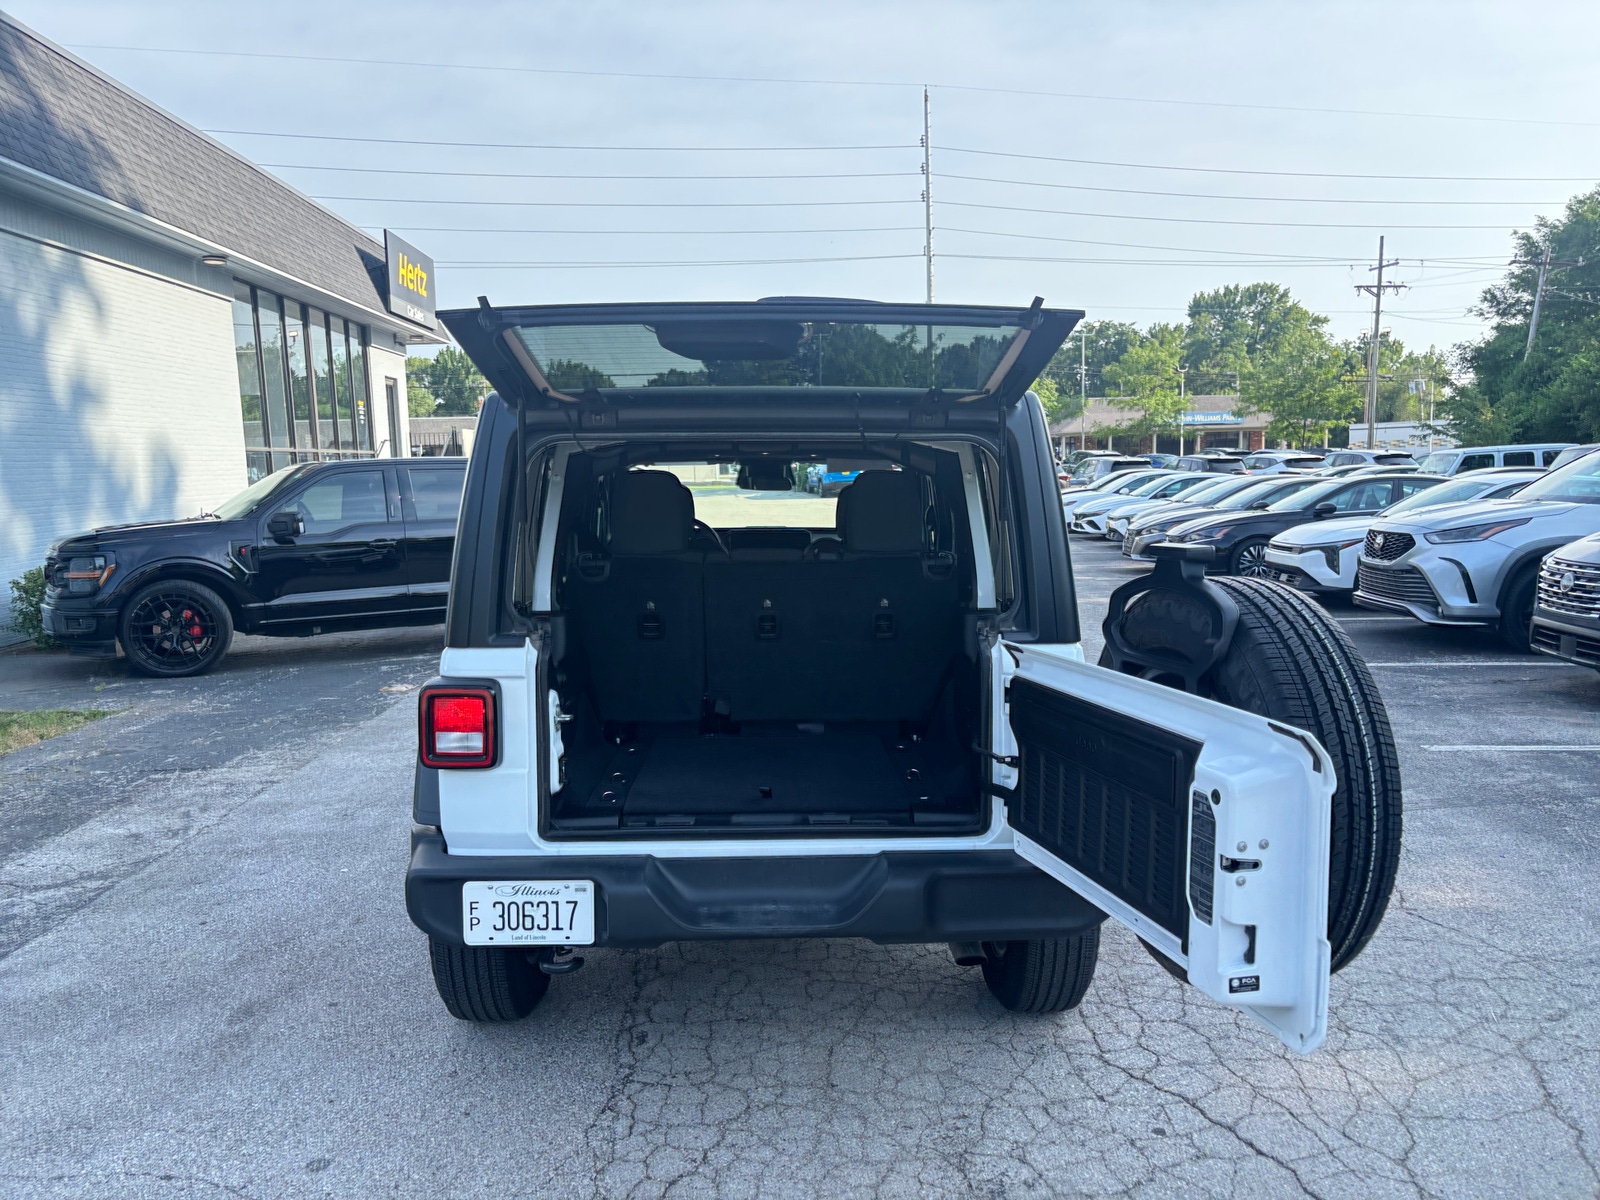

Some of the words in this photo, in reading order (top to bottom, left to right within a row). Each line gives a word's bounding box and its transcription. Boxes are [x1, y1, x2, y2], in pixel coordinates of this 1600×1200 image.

[398, 252, 427, 298] Hertz
[495, 884, 561, 897] Illinois
[492, 900, 579, 931] 306317
